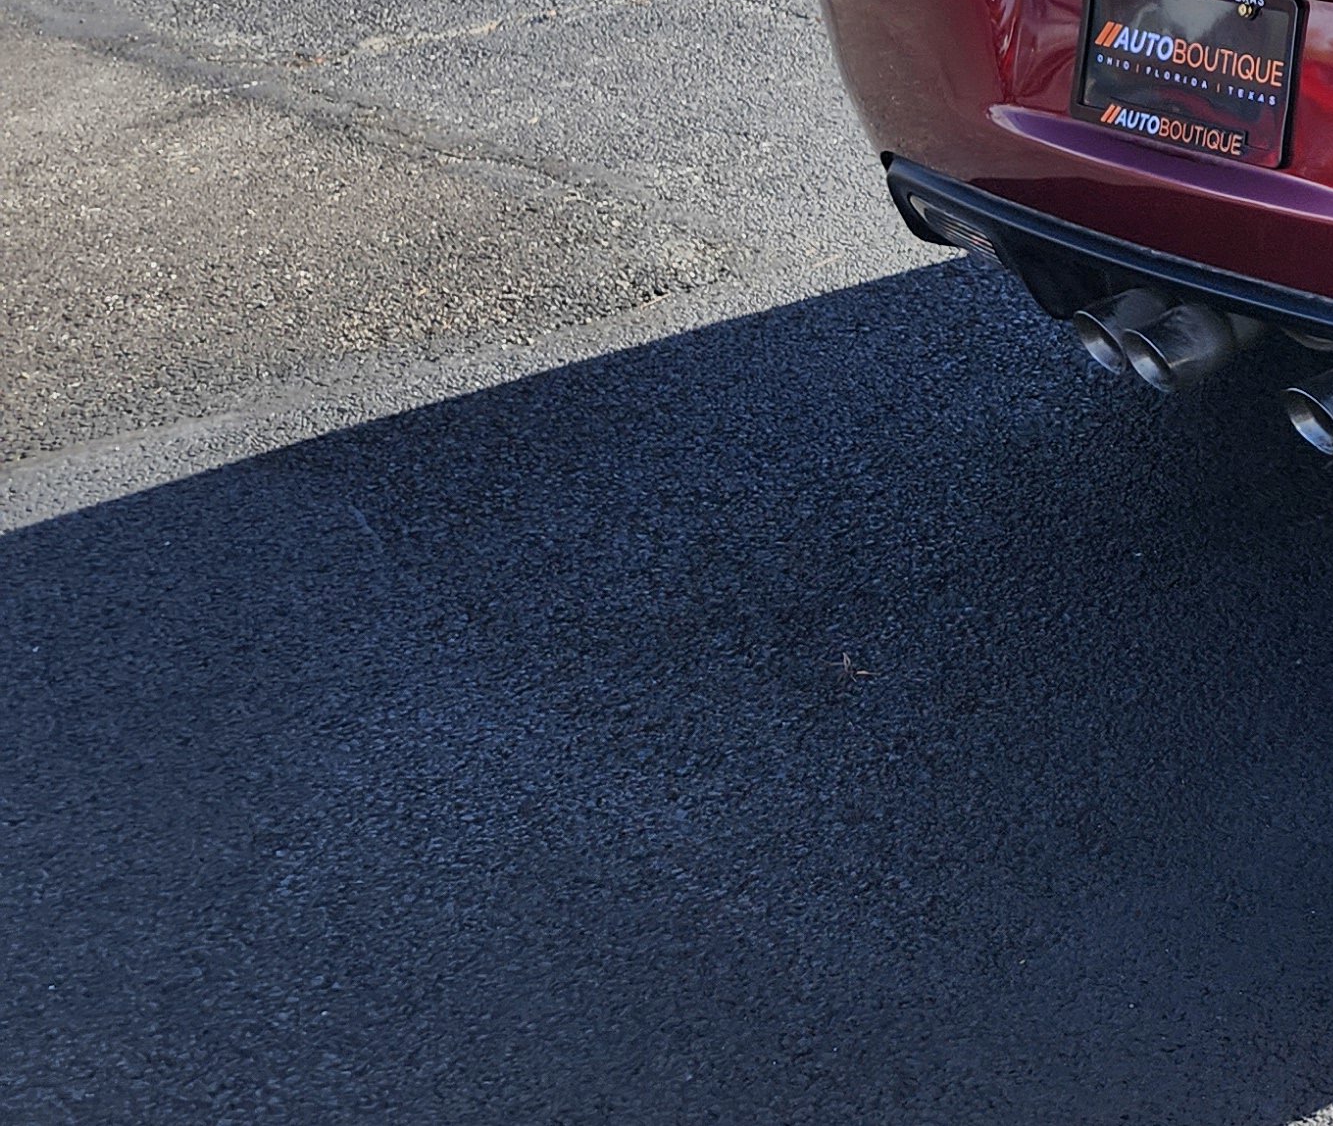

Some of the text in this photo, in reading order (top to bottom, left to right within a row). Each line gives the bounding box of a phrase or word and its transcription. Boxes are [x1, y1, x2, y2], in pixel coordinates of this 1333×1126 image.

[1097, 54, 1276, 106] OHIO FLORIDA TEXAS
[1114, 26, 1285, 87] AUTOBOUTIQUE
[1114, 108, 1244, 156] AUTOBOUTIQUE
